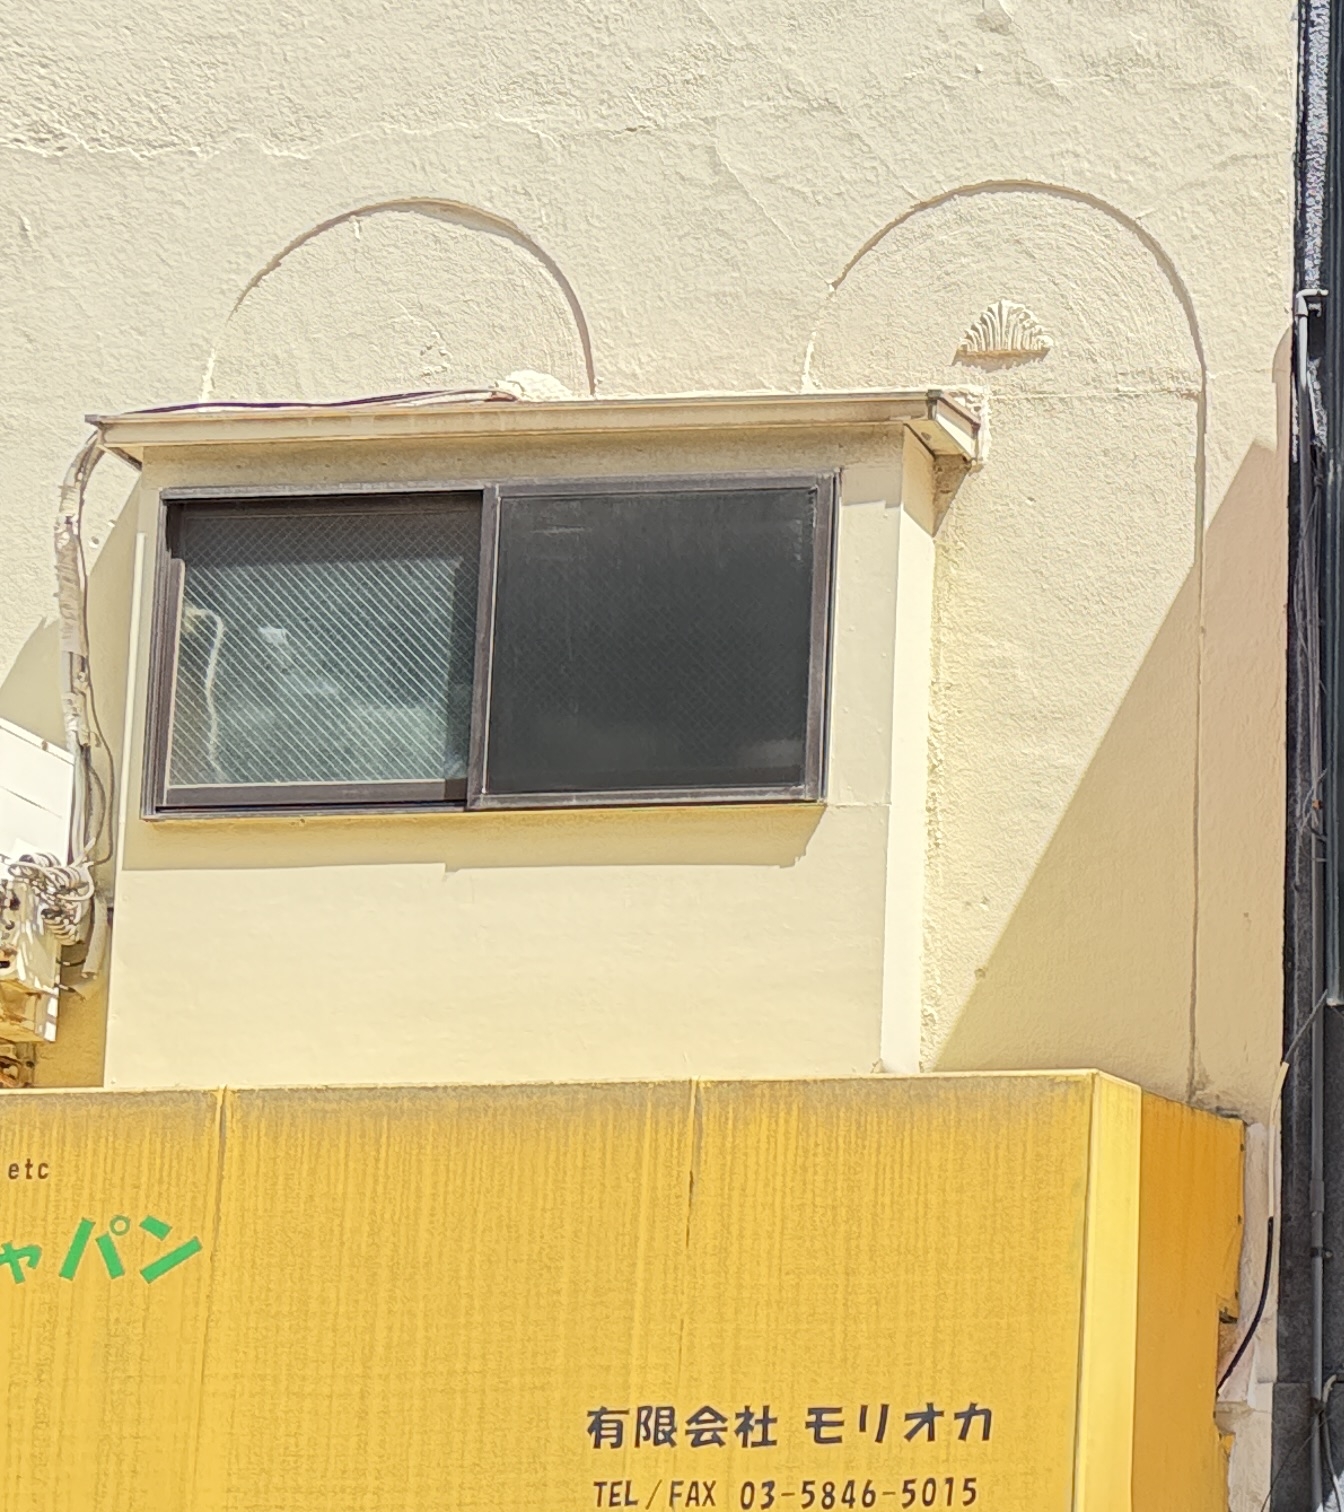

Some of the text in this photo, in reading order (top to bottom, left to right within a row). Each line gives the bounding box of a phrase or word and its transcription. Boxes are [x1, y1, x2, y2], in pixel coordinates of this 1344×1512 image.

[8, 1158, 49, 1180] etc
[586, 1402, 993, 1449] 有限会社 モリオカ
[740, 1477, 979, 1511] 03-5846-5015
